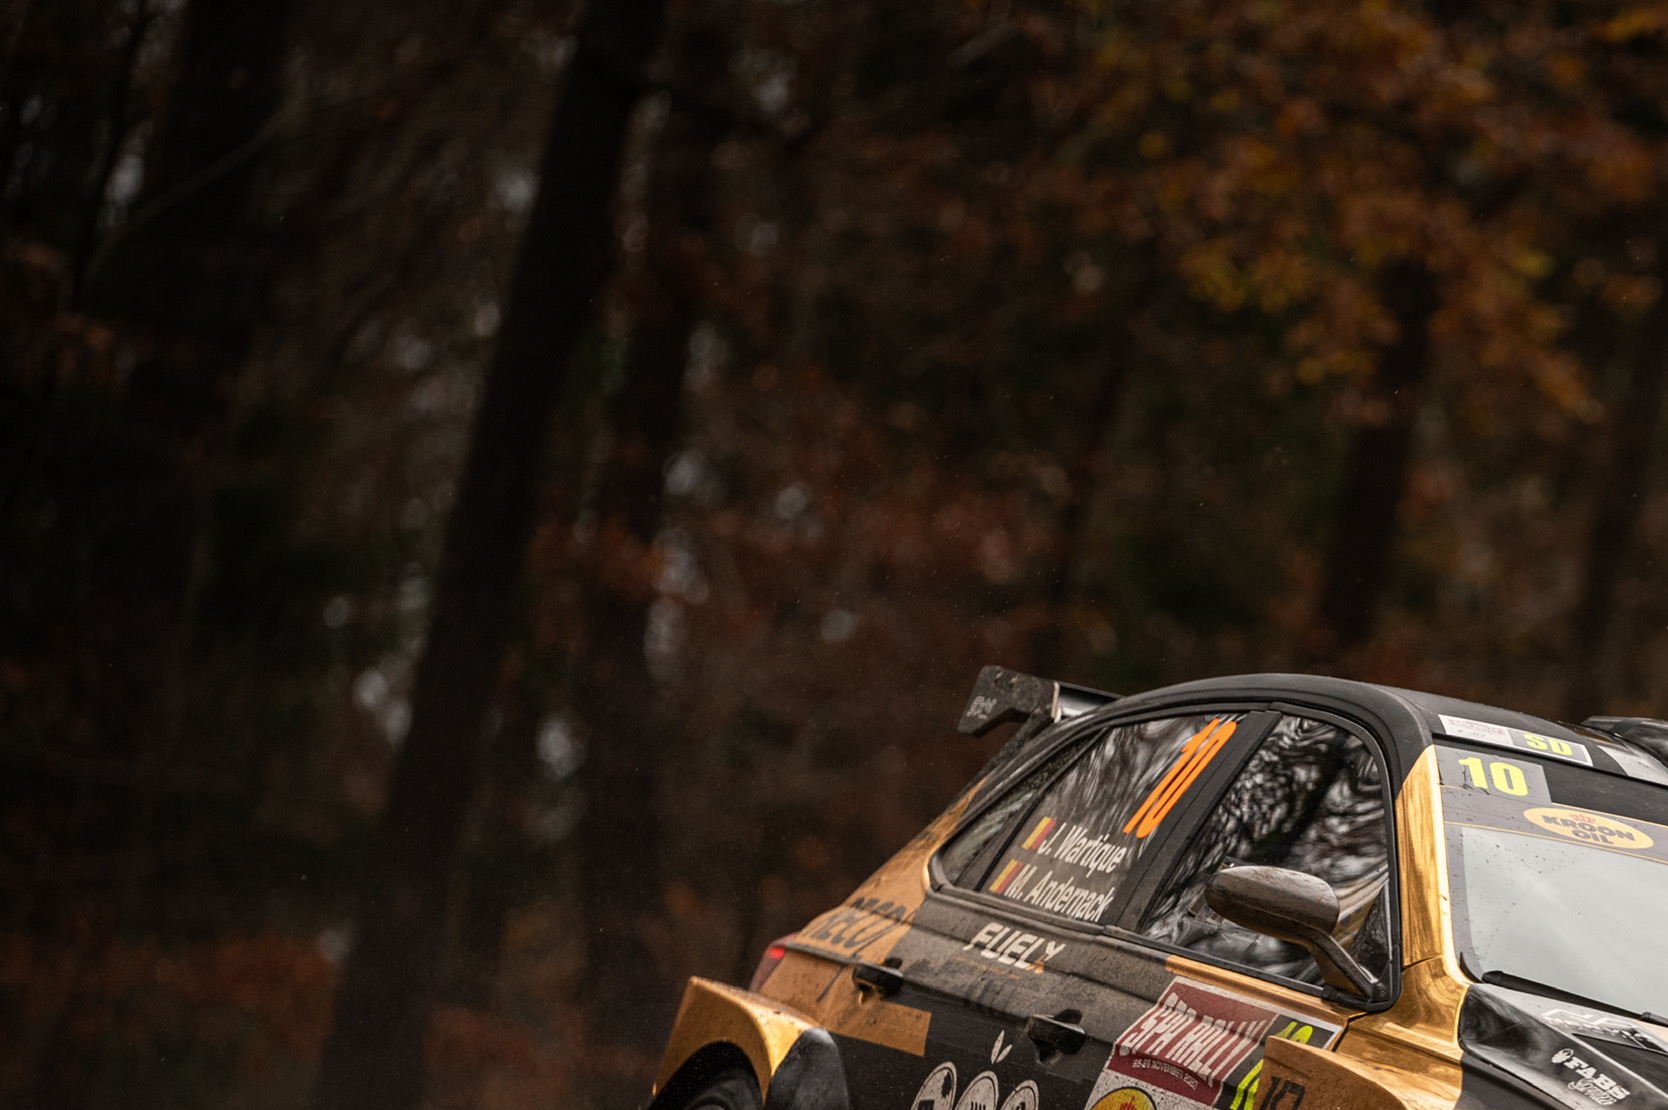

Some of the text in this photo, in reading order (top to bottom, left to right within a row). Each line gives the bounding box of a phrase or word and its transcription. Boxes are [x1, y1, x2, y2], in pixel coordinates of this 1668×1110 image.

[1123, 718, 1236, 838] 10
[1458, 756, 1528, 796] 10
[1541, 814, 1636, 841] KROON
[1571, 829, 1614, 845] OIL
[1037, 822, 1127, 878] J. Wartique
[1003, 863, 1115, 922] M. Andernack
[1119, 992, 1267, 1088] SPA RALLY
[1151, 1060, 1184, 1080] NOVEMBER
[1563, 1056, 1631, 1100] FABS
